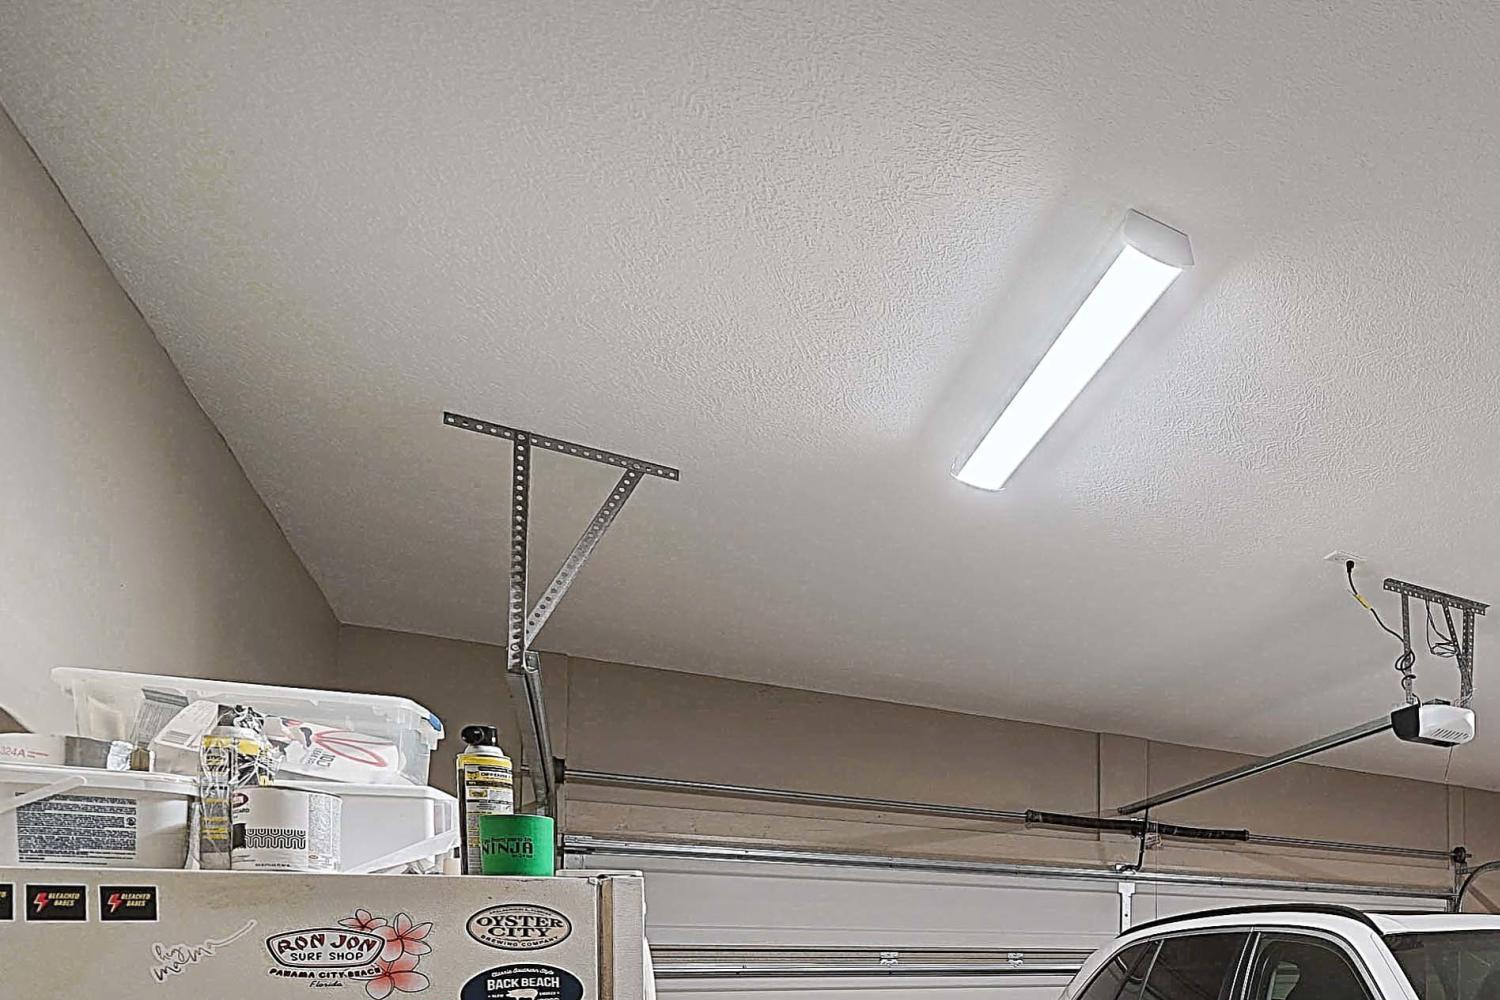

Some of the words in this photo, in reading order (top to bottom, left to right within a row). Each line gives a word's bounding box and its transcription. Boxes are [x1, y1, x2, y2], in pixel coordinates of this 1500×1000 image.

[481, 841, 533, 855] NINJA
[476, 914, 564, 928] OYSTER
[487, 927, 551, 938] CITY
[277, 933, 326, 955] RON
[330, 934, 377, 952] JON
[480, 934, 518, 947] BREWING
[521, 935, 559, 947] COMPANY
[290, 952, 322, 961] SURF
[329, 951, 364, 961] SHOP
[269, 968, 315, 979] PANAMA
[318, 971, 345, 979] CITY
[346, 967, 381, 978] BEACH
[309, 980, 343, 988] Florida
[487, 978, 519, 991] BACK
[521, 976, 560, 988] BEACH
